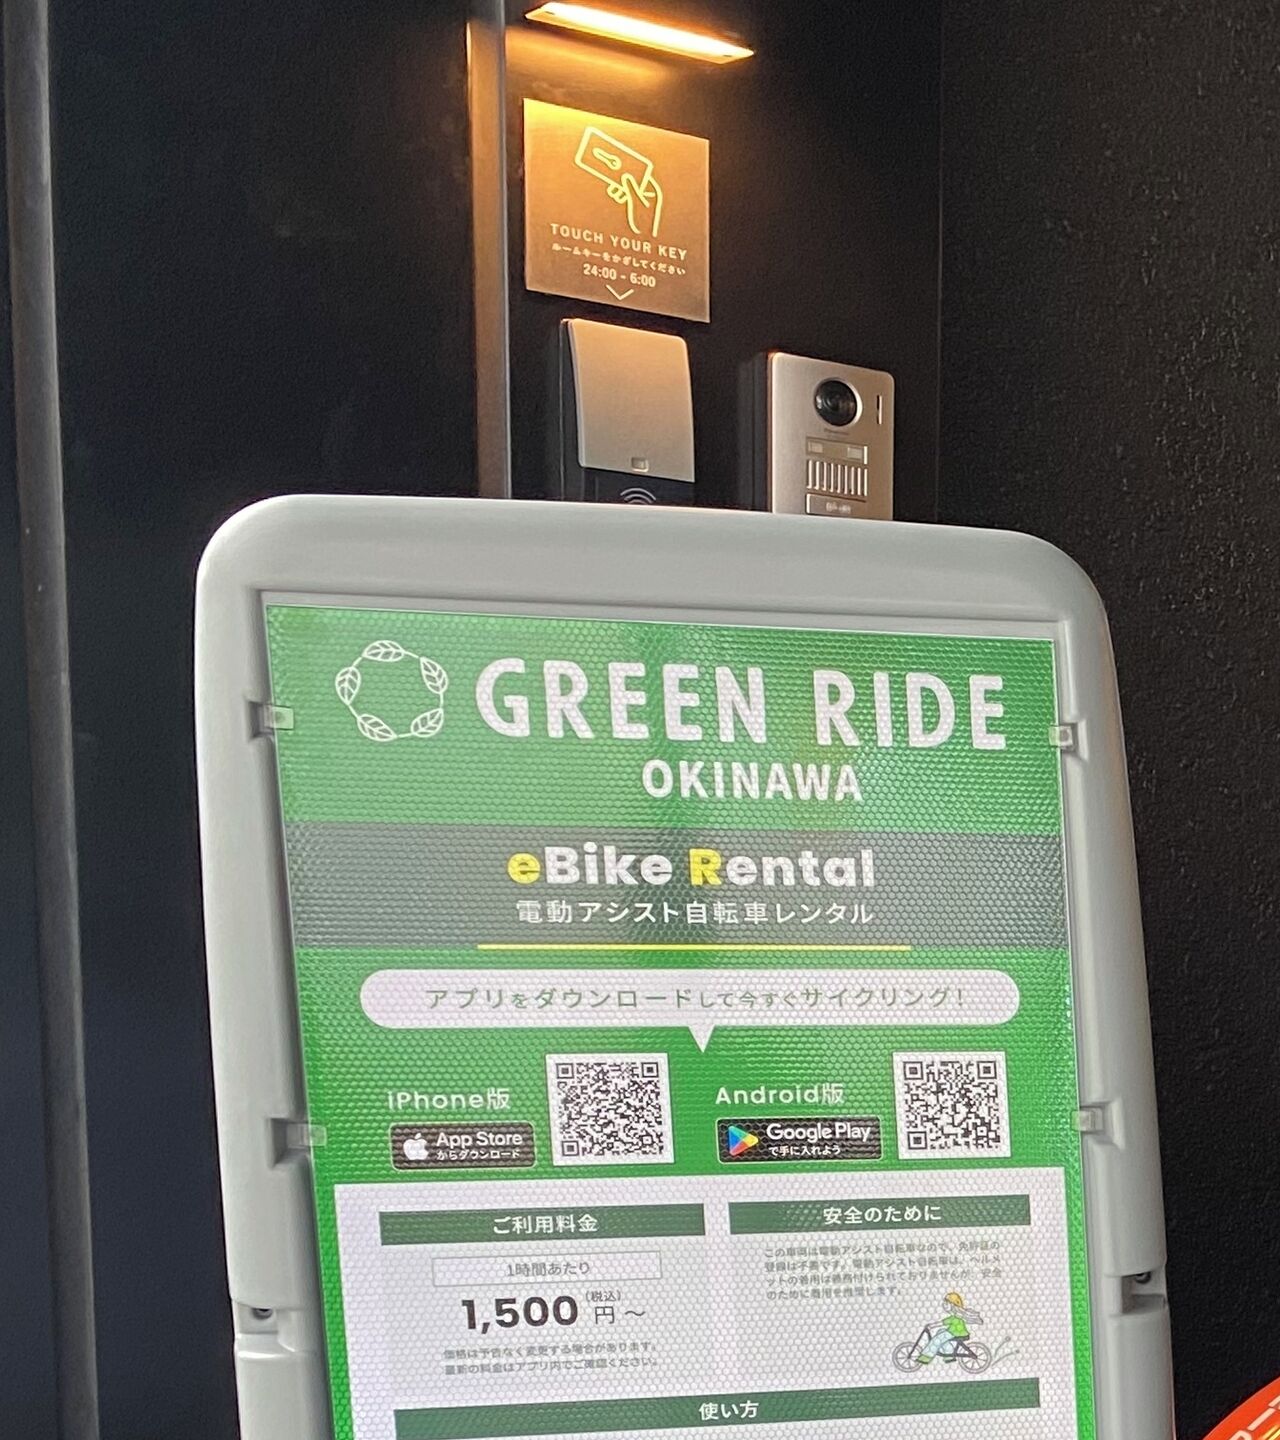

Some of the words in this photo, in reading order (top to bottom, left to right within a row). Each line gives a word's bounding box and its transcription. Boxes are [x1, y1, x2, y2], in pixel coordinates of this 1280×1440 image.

[550, 223, 604, 243] TOUCH
[609, 235, 651, 253] YOUR
[658, 245, 687, 261] KEY
[583, 263, 617, 280] 24:00
[630, 273, 656, 288] 6:00
[475, 656, 768, 744] GREEN
[815, 670, 1008, 750] RIDE
[641, 759, 862, 802] OKINAWA
[507, 842, 672, 887] eBike
[688, 846, 876, 889] Rental
[516, 899, 873, 926] 電動アシスト自転車レンタル
[387, 1087, 511, 1111] iPhone版
[716, 1083, 845, 1106] Android版
[437, 1133, 472, 1150] App
[476, 1131, 523, 1147] Store
[767, 1123, 832, 1143] Google
[835, 1123, 872, 1142] Play
[437, 1147, 521, 1161] からダウンロード
[769, 1144, 842, 1158] で手に入れよう
[493, 1213, 598, 1235] ご利用料金
[823, 1204, 943, 1226] 安全のために
[507, 1261, 590, 1277] 1時間あたり
[461, 1295, 578, 1334] 1,500
[698, 1399, 760, 1421] 使い方
